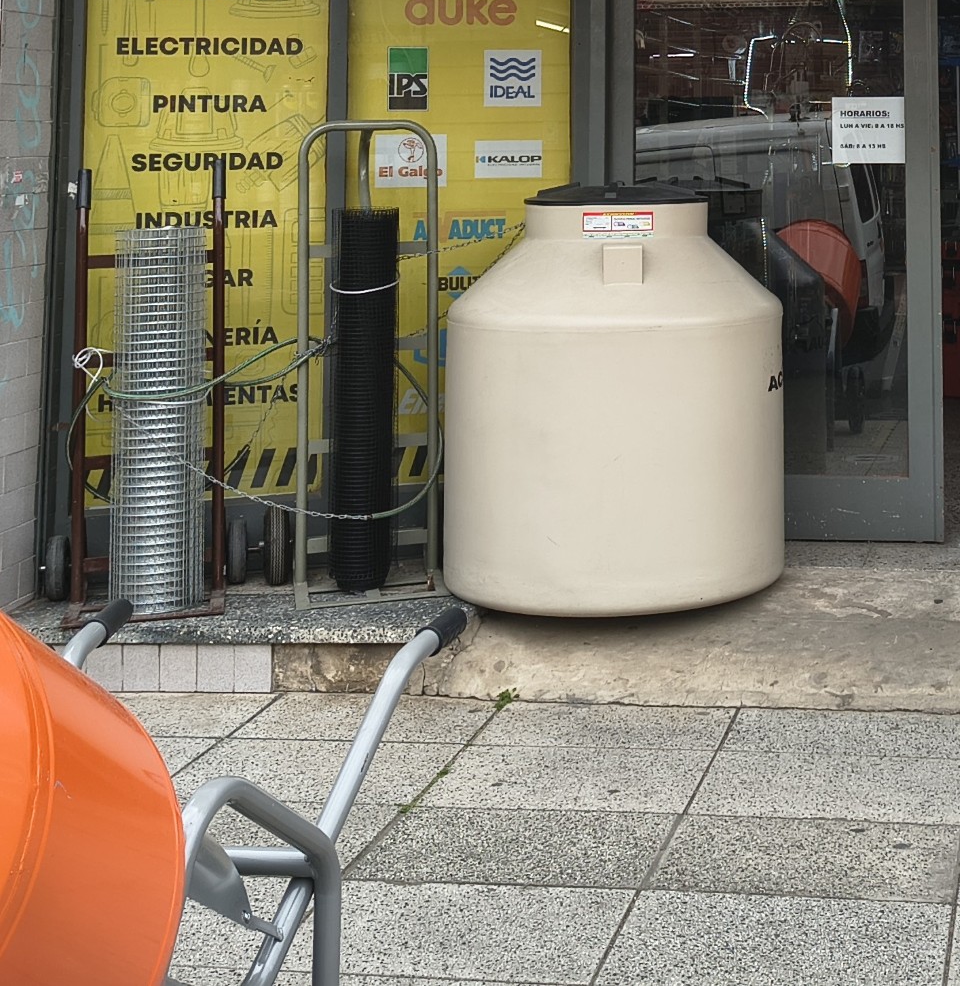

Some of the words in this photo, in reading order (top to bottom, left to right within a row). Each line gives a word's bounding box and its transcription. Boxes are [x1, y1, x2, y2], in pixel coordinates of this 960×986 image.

[116, 36, 304, 58] ELECTRICIDAD
[388, 73, 428, 97] IPS
[489, 85, 536, 100] IDEAL
[152, 94, 267, 114] PINTURA
[839, 110, 890, 118] HORARIOS:
[487, 155, 543, 164] KALOP
[378, 165, 394, 178] El
